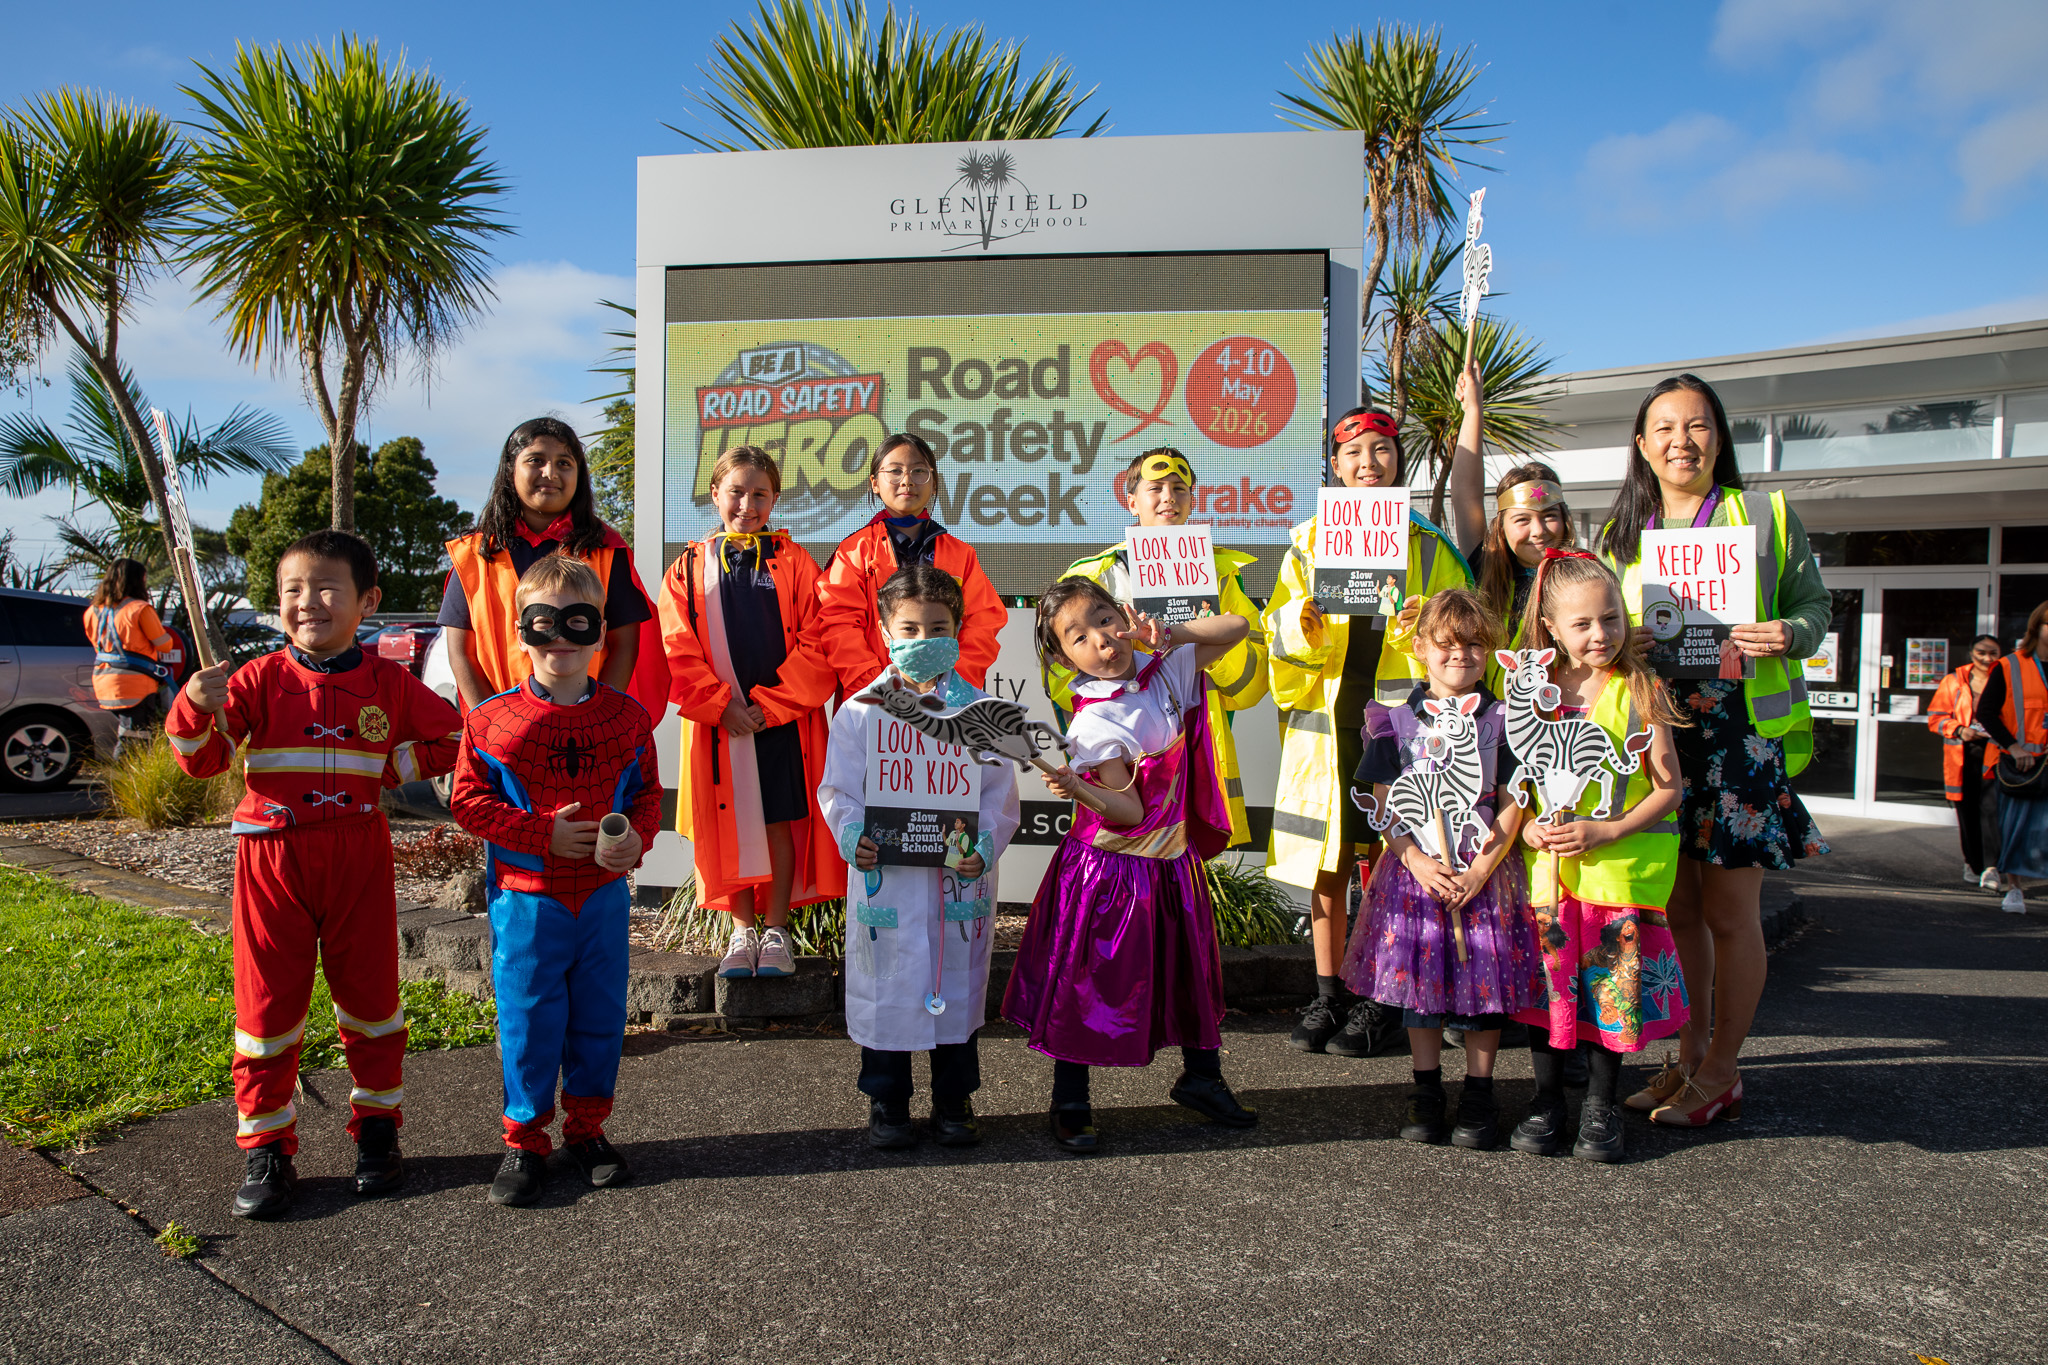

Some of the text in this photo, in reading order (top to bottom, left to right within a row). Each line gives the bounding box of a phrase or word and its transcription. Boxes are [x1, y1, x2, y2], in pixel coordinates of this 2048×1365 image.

[890, 193, 1088, 216] GLENFIELD
[890, 216, 1088, 232] PRIMARY SCHOOL
[749, 350, 797, 376] BE A
[907, 343, 1071, 401] Road
[1216, 345, 1276, 377] 4-10
[703, 380, 876, 421] ROAD SAFETY
[1221, 377, 1264, 407] May
[1208, 405, 1269, 437] 2026
[905, 407, 1108, 475] Safety
[1191, 475, 1295, 515] rake
[1323, 499, 1405, 527] LOOK OUT
[1132, 535, 1207, 562] LOOK OUT
[1325, 529, 1400, 558] FOR KIDS
[1656, 543, 1741, 577] KEEP US
[1138, 561, 1209, 588] FOR KIDS
[1347, 579, 1375, 588] Down
[1350, 570, 1374, 580] Slow
[1167, 598, 1189, 607] Slow
[1343, 586, 1378, 596] Around
[1343, 595, 1379, 604] Schools
[1668, 578, 1726, 612] SAFE!
[1162, 610, 1196, 621] Around
[1165, 605, 1192, 615] Down
[1683, 637, 1716, 648] Down
[1685, 627, 1714, 637] Slow
[1678, 645, 1720, 657] Around
[1679, 655, 1721, 666] Schools
[877, 718, 926, 756] LOOK
[879, 757, 971, 797] FOR KIDS
[907, 822, 940, 833] Down
[910, 811, 938, 823] Slow
[901, 832, 944, 843] Around
[901, 842, 944, 853] Schools
